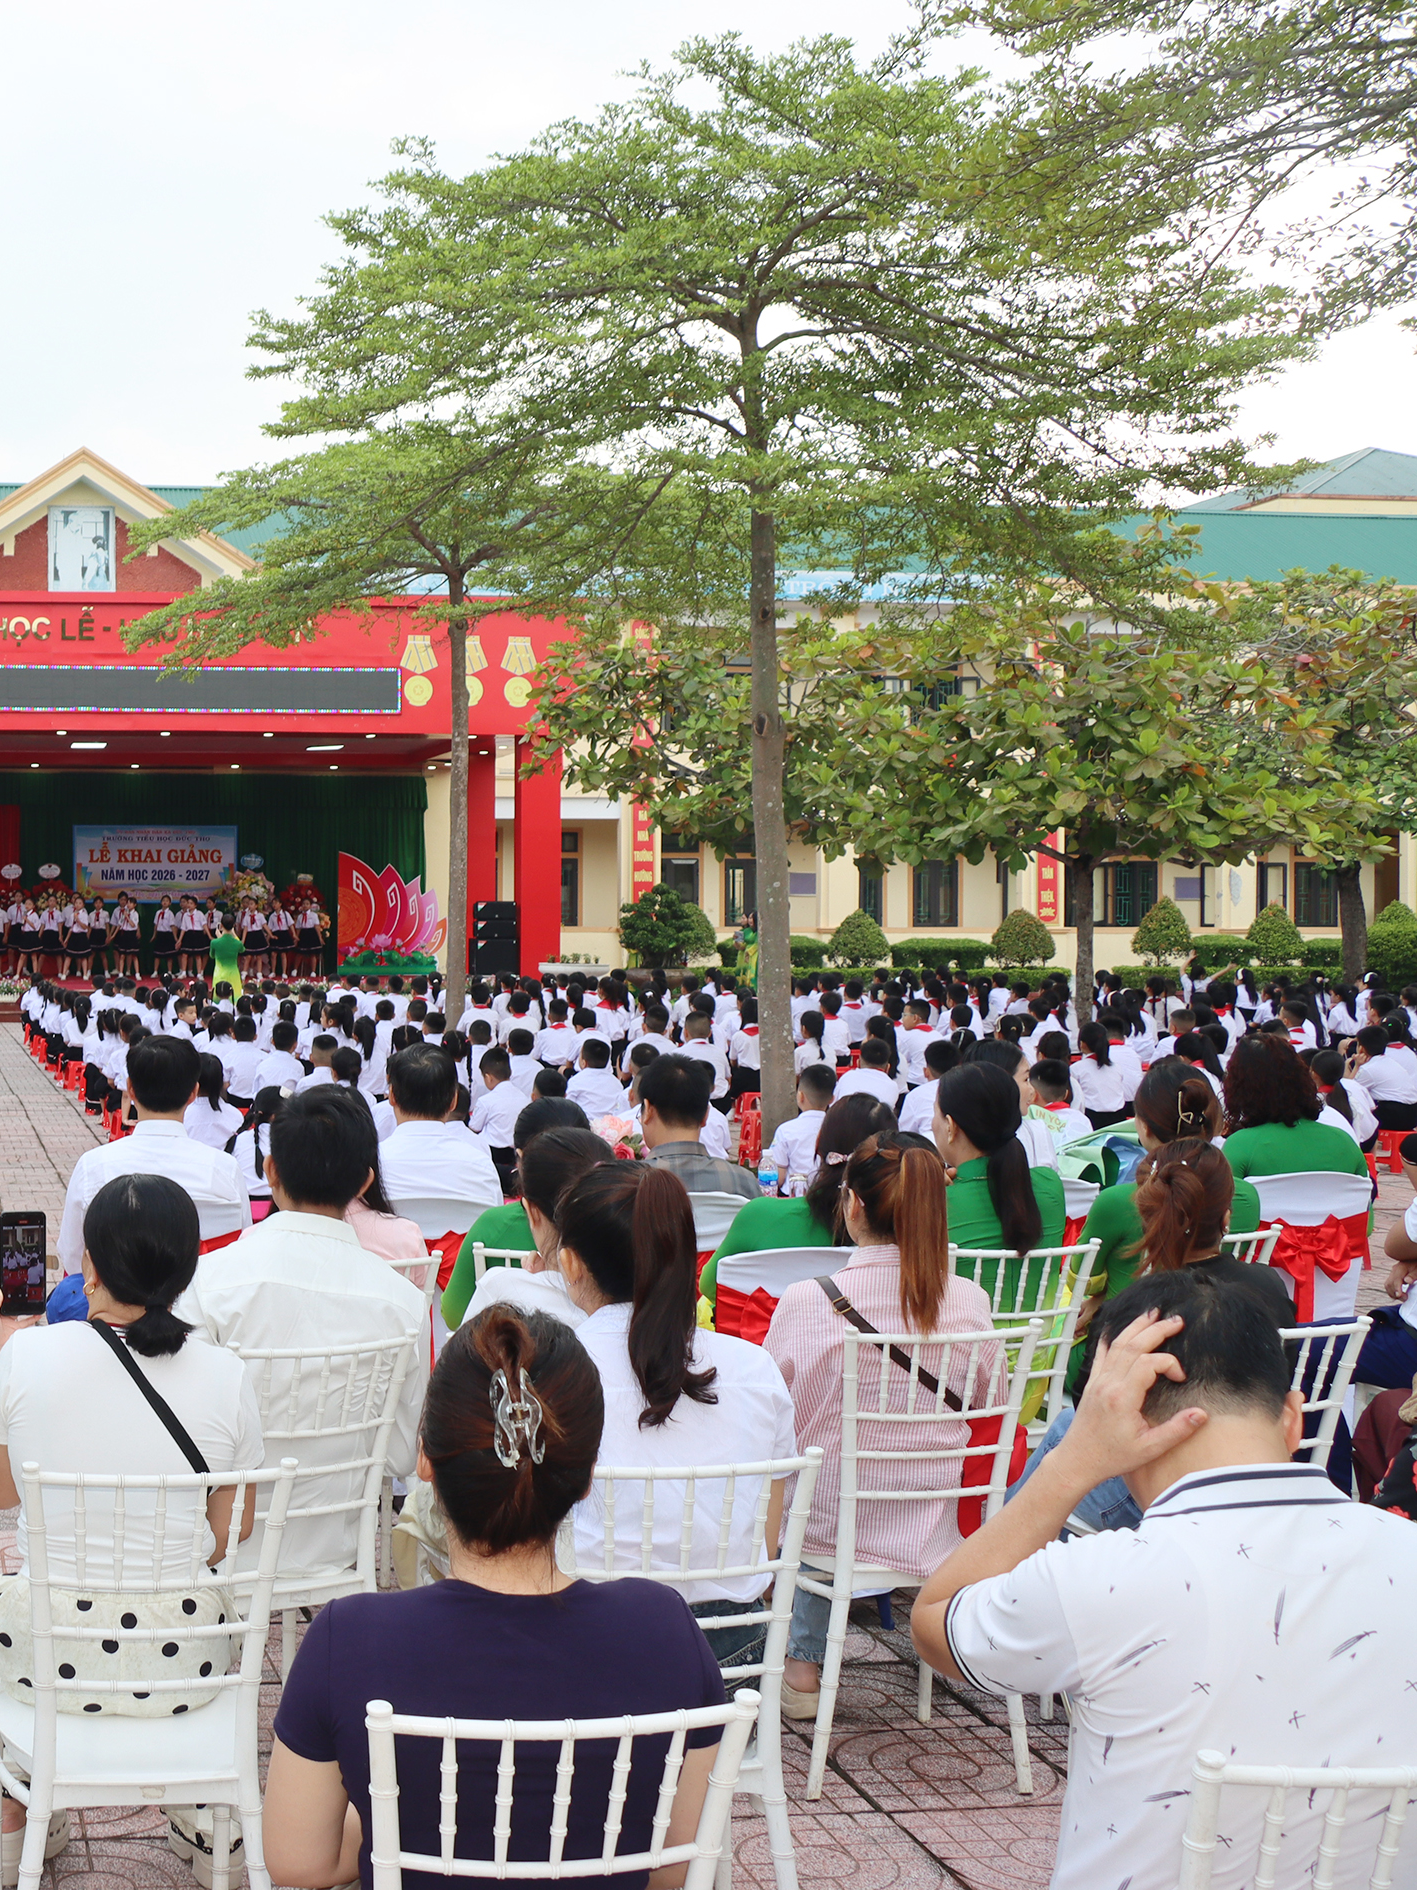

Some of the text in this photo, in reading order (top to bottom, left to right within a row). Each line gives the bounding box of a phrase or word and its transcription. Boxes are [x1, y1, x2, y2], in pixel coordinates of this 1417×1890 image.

[61, 606, 95, 641] LỄ
[88, 842, 111, 863] LỄ
[117, 849, 162, 863] KHAI
[167, 844, 222, 864] GIẢNG
[101, 867, 125, 881] NĂM
[128, 869, 148, 883] HỌC
[151, 869, 175, 881] 2026
[185, 869, 210, 881] 2027
